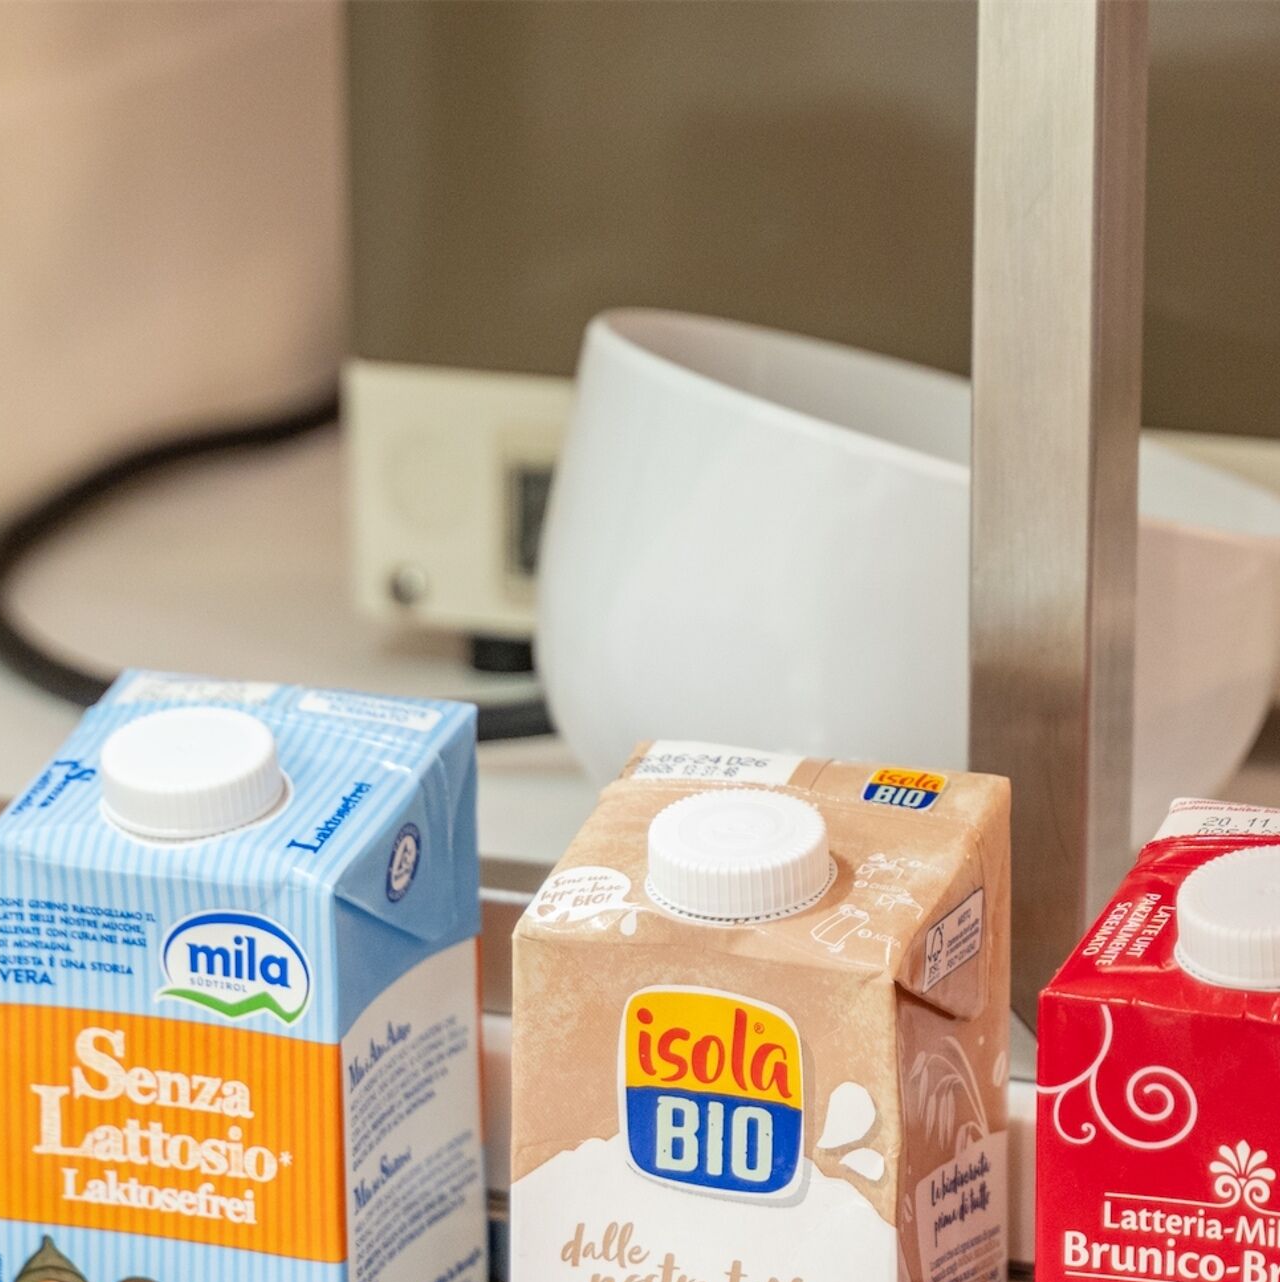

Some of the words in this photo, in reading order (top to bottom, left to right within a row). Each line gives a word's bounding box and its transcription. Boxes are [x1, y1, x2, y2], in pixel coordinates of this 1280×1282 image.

[877, 770, 944, 790] isola
[874, 785, 926, 808] BIO
[287, 781, 373, 854] Laktosefrei
[72, 903, 143, 921] RACCOGLIAMO
[572, 893, 611, 908] BIO!
[60, 916, 99, 928] NOSTRE
[71, 930, 98, 942] CURA
[1082, 901, 1133, 957] SCREMATO
[1094, 892, 1162, 966] PARZIALMENTE
[1141, 905, 1177, 937] LATTE
[187, 934, 291, 990] mila
[1126, 936, 1155, 958] UHT
[61, 957, 88, 970] UNA
[91, 961, 134, 975] STORIA
[189, 976, 249, 994] SÜDTIROL
[636, 1007, 793, 1100] isola
[72, 1026, 255, 1120] Senza
[655, 1094, 774, 1183] BIO
[61, 1168, 258, 1225] Laktosefrei
[561, 1221, 651, 1268] dalle
